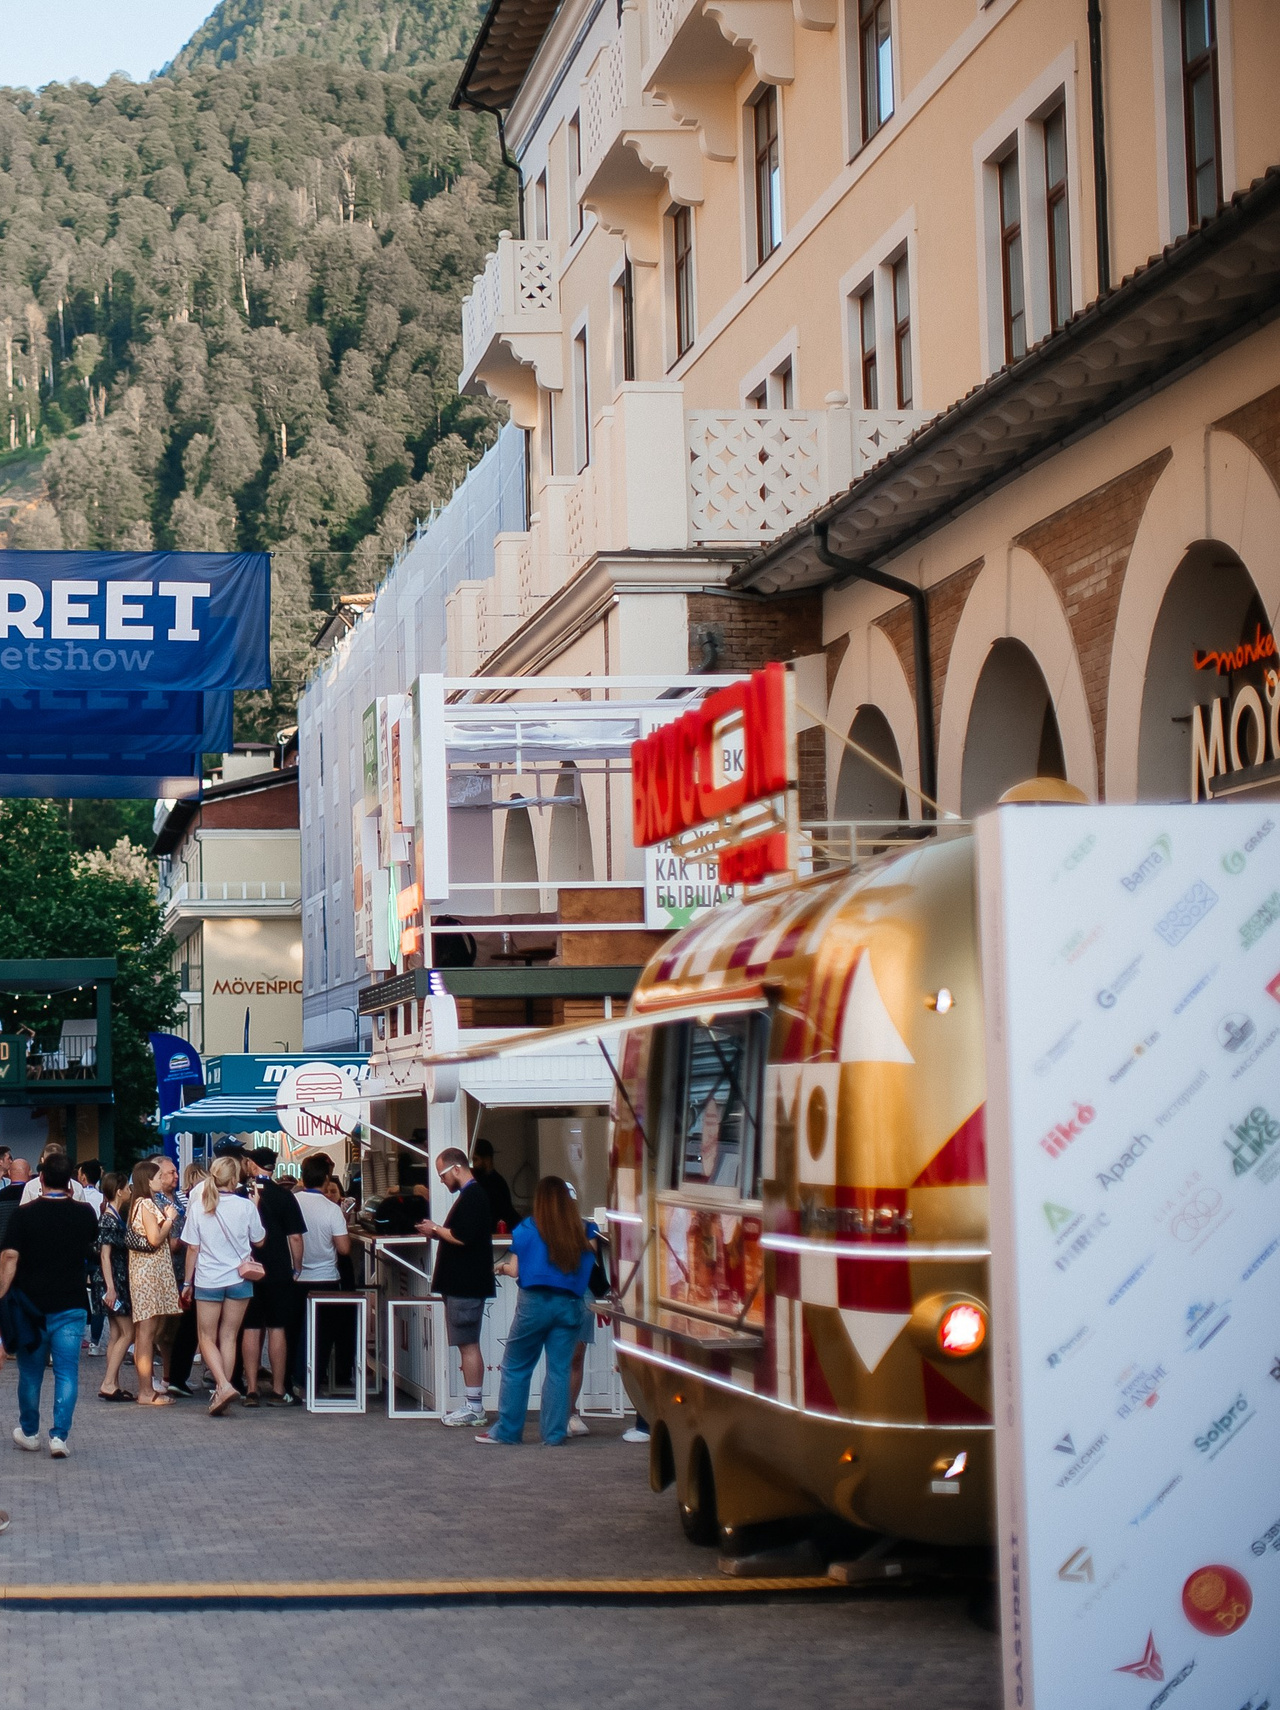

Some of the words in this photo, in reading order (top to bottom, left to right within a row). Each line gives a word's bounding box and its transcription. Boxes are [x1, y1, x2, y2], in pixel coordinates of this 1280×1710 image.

[1193, 622, 1277, 676] monke
[1244, 818, 1276, 853] GRASS
[655, 858, 690, 881] КАК
[1121, 851, 1163, 892] Валта
[656, 884, 735, 908] БЫВШАЯ
[212, 977, 303, 996] MÖVENPIC
[297, 1114, 344, 1137] ШМАК
[1039, 1100, 1096, 1160] iiko
[1095, 1133, 1154, 1192] Apach
[1193, 1393, 1248, 1453] Solpro
[1056, 1433, 1111, 1489] VASILCHUKI
